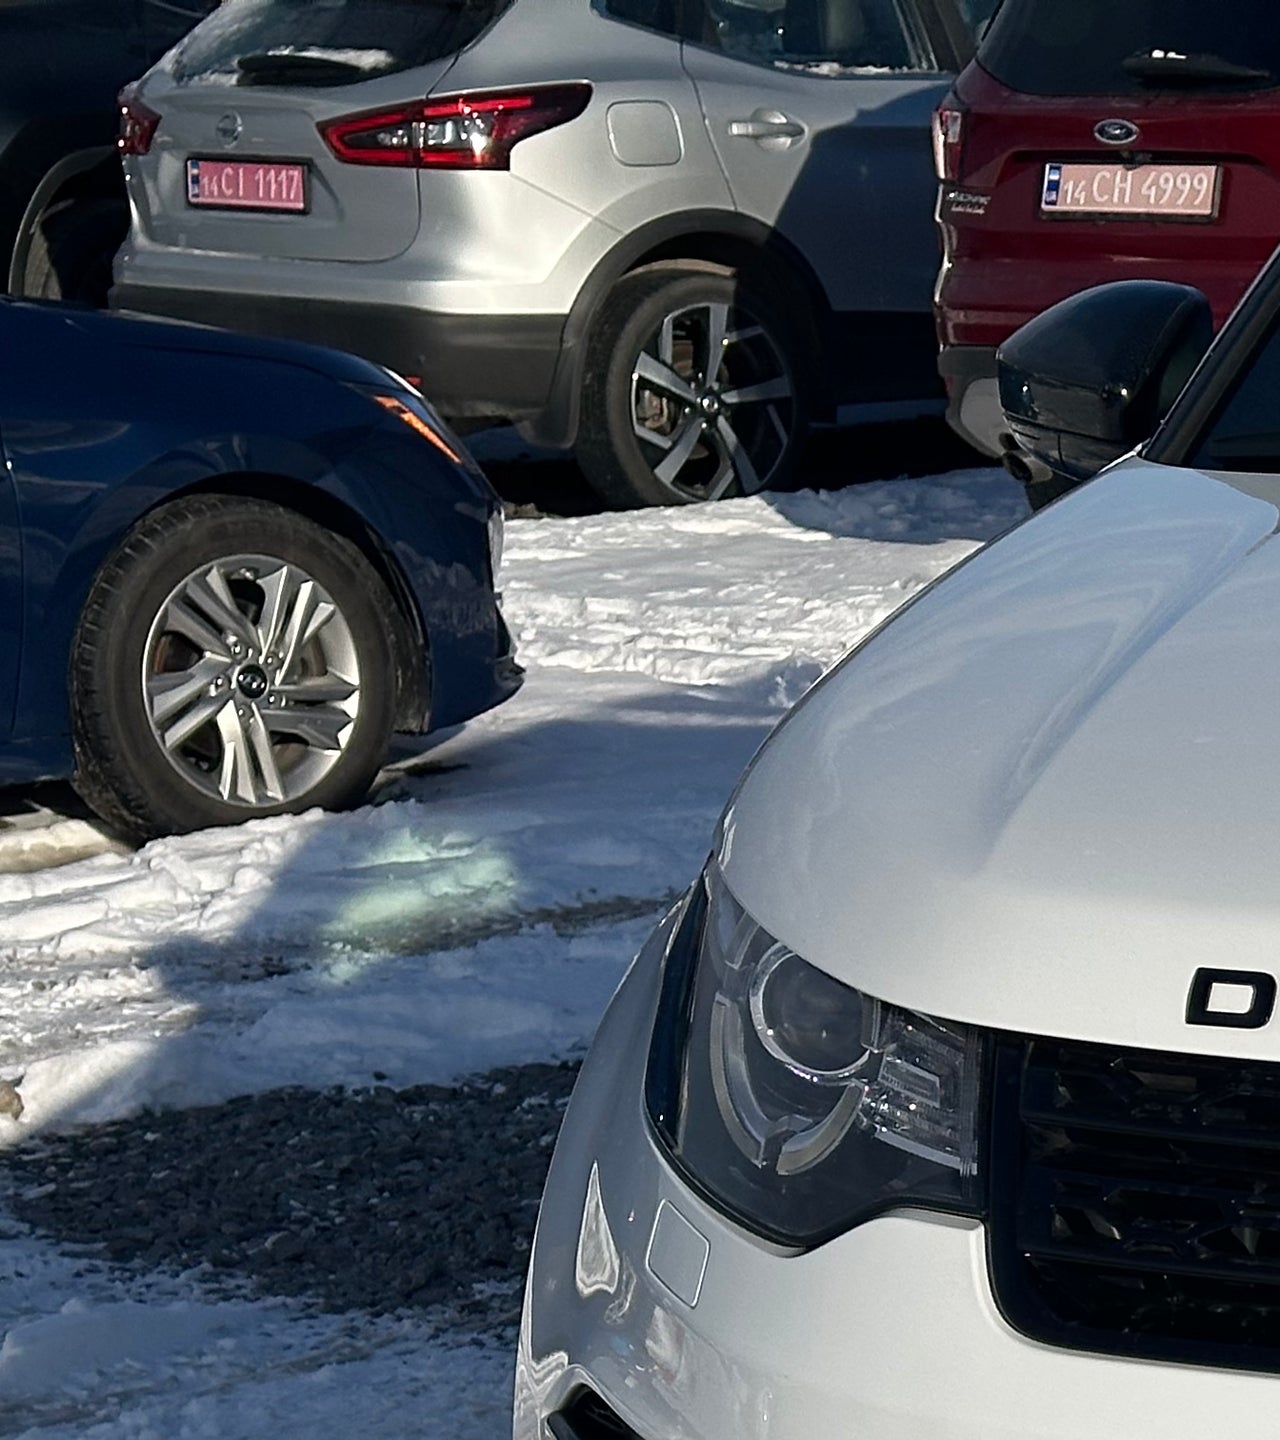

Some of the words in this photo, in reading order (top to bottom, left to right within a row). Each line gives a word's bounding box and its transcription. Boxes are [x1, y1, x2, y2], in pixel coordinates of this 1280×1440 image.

[255, 168, 299, 200] 1117
[1093, 170, 1132, 204] CH
[1141, 171, 1208, 205] 4999
